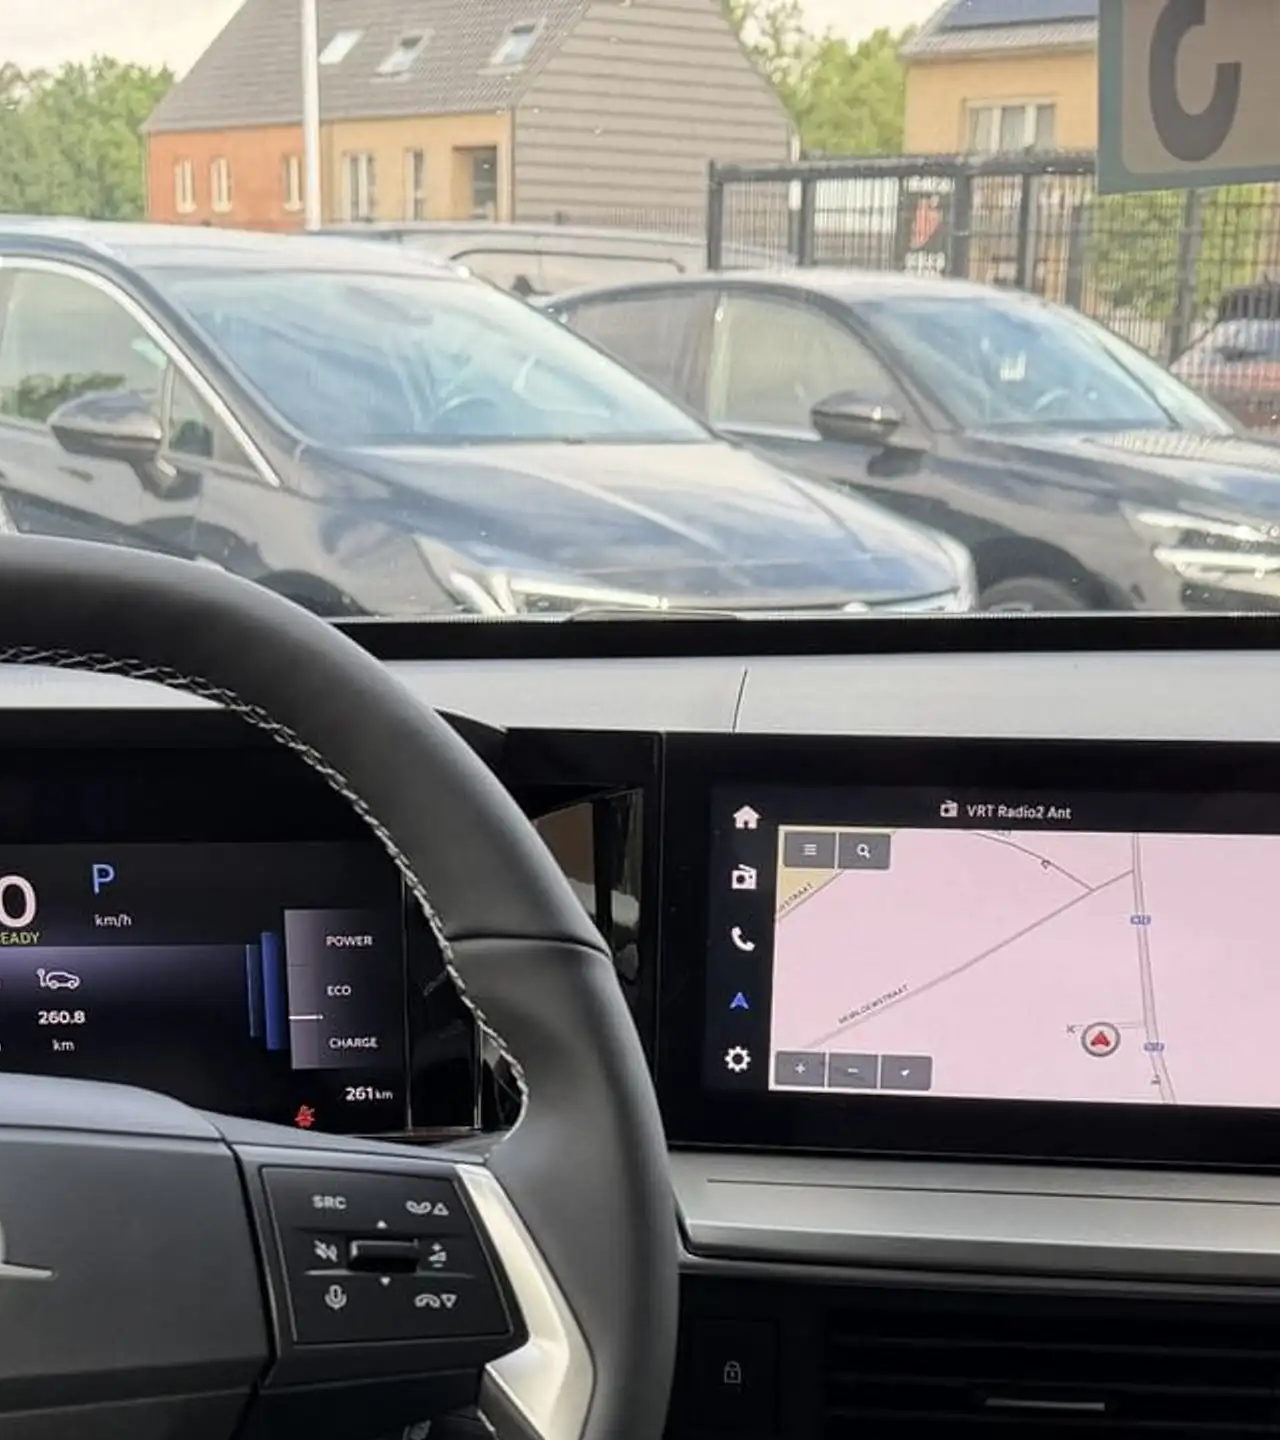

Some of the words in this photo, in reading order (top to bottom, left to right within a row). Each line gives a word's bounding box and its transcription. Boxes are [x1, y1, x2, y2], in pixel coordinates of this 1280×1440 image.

[966, 804, 995, 818] VRT
[998, 804, 1045, 819] Radio2
[1047, 805, 1072, 820] Ant
[91, 864, 115, 894] P
[94, 913, 133, 927] km/h
[325, 935, 373, 947] POWER
[326, 984, 352, 997] ECO
[37, 1010, 86, 1025] 260.8
[51, 1039, 75, 1051] km
[328, 1036, 379, 1049] CHARGE
[311, 1194, 348, 1210] SRC
